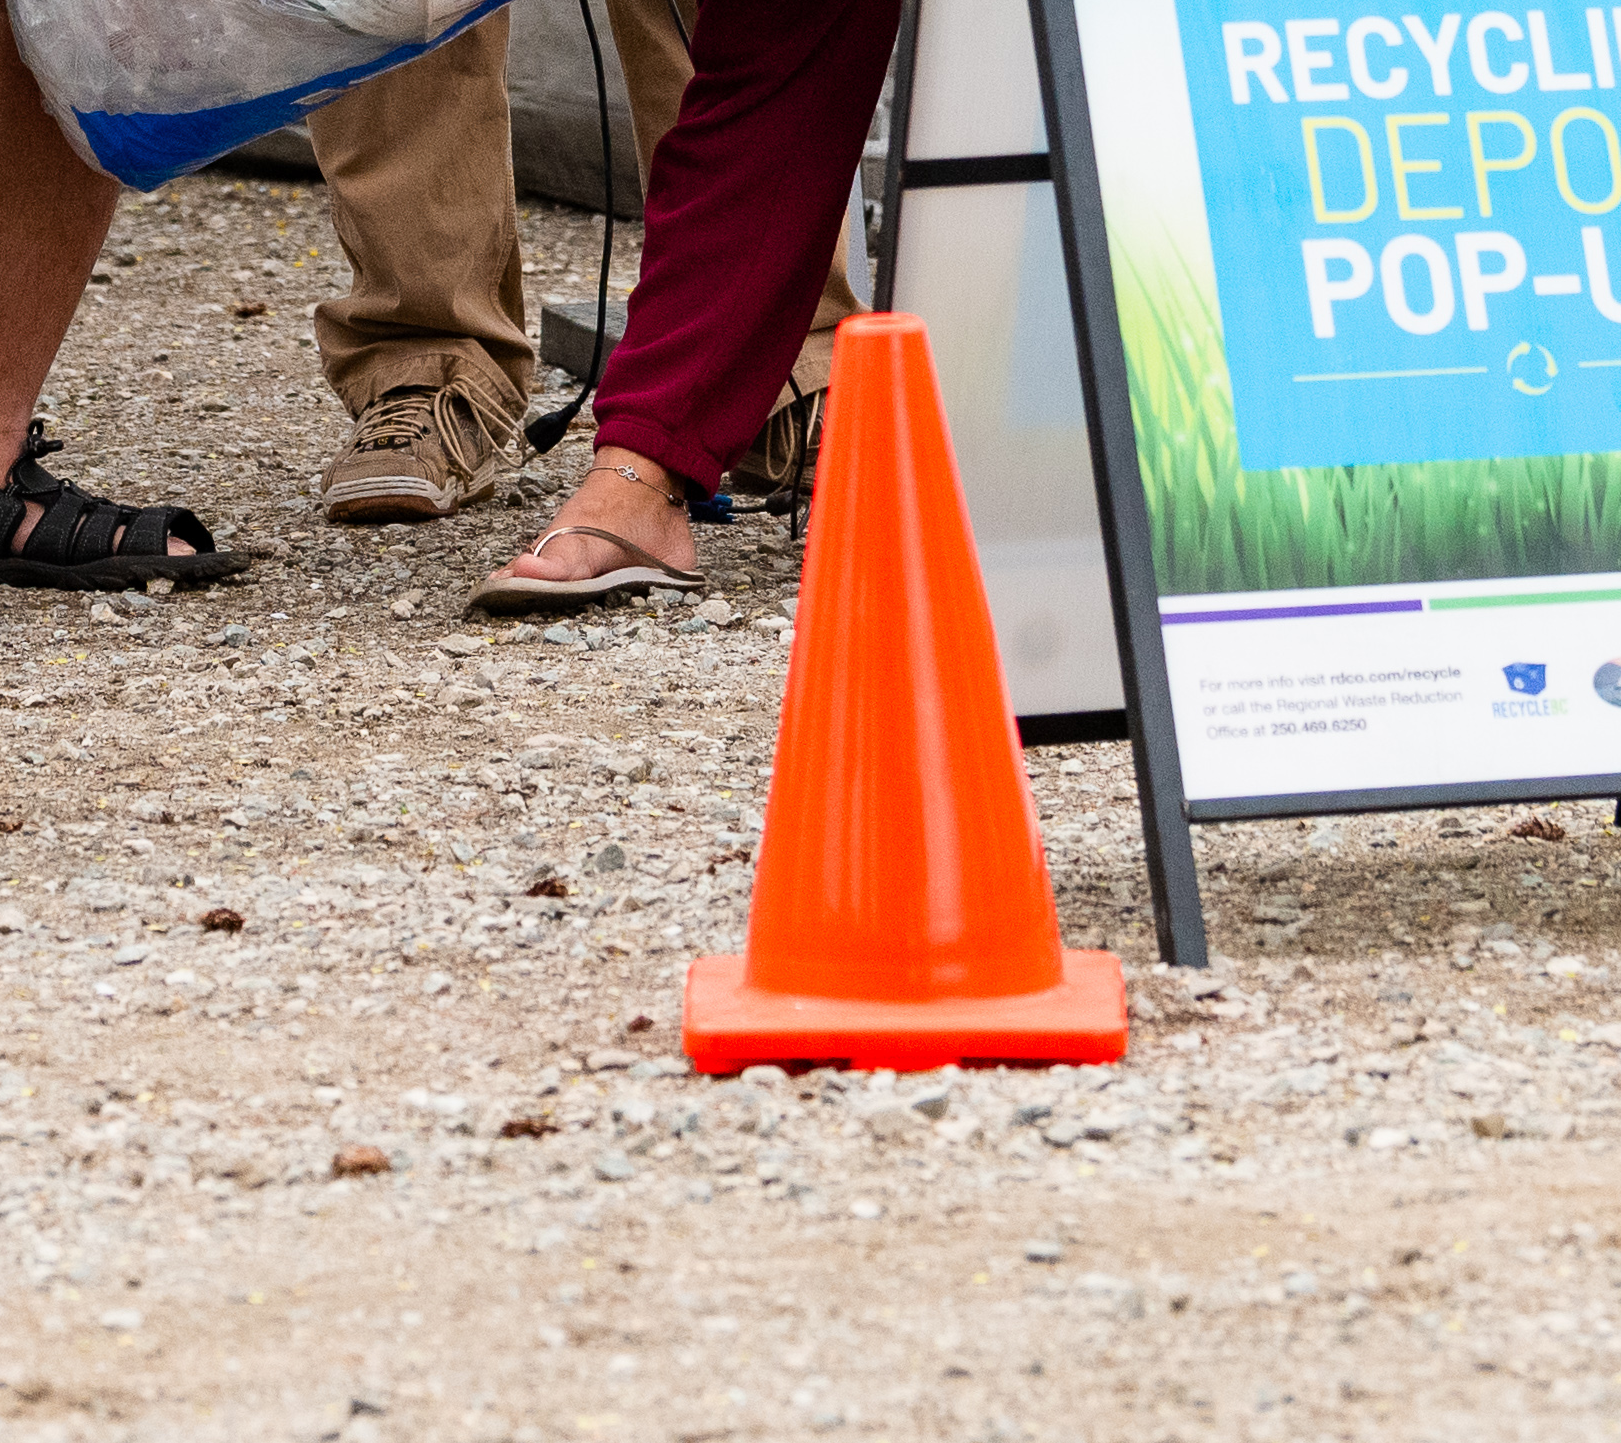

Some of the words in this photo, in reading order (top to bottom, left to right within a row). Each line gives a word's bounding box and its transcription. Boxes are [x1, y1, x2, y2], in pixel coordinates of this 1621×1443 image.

[1199, 679, 1222, 693] For
[1227, 679, 1263, 691] more
[1267, 675, 1294, 689] info
[1299, 674, 1325, 687] visit
[1330, 665, 1461, 686] rdco.com/recycle
[1204, 705, 1217, 716] or
[1222, 701, 1245, 715] call
[1250, 701, 1272, 713] the
[1277, 697, 1338, 714] Regional
[1343, 694, 1386, 708] Waste
[1391, 690, 1463, 705] Reduction
[1492, 698, 1568, 718] RECYCLEBC
[1207, 726, 1248, 739] Office
[1253, 725, 1266, 737] at
[1271, 718, 1367, 736] 250.469.6250
